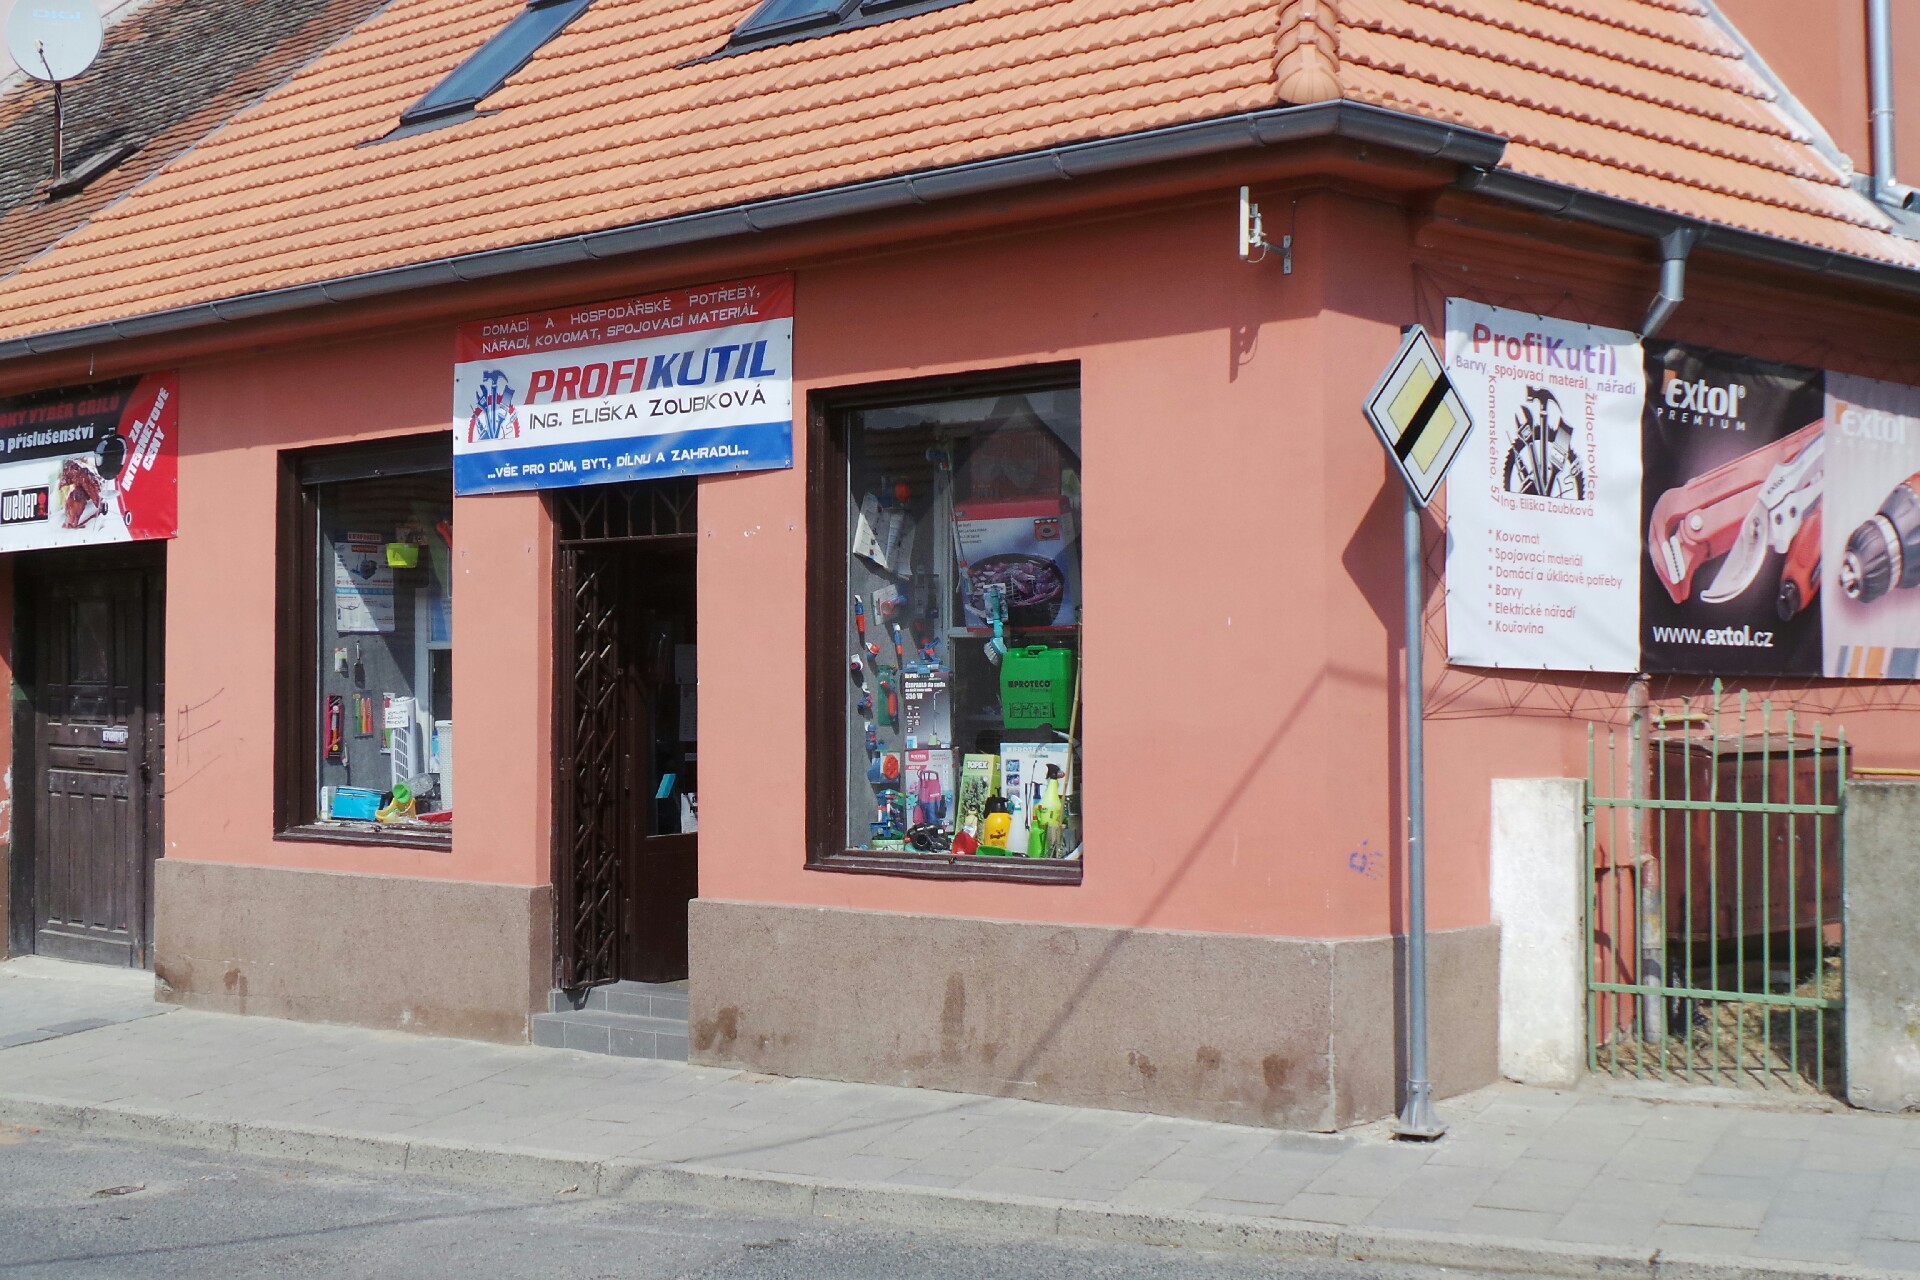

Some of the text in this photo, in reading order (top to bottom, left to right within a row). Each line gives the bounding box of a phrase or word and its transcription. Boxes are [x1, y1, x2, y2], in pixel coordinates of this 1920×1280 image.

[482, 285, 760, 336] DOMÁCÍ A HOSPODÁŘSKÉ POTŘEBY,
[482, 303, 759, 354] NÁŘADÍ, KOVOMAT, SPOJOVACÍ MATERIÁL
[1472, 322, 1616, 376] ProfiKutil
[1494, 363, 1544, 382] spojovací
[1597, 380, 1636, 395] nářadí
[529, 384, 766, 430] ING. ELIŠKA ZOUBKOVÁ
[1657, 407, 1746, 431] PREMIUM
[7, 422, 94, 454] příslušenství
[128, 420, 144, 443] ZA
[142, 425, 165, 471] CENY
[522, 464, 545, 476] PRO
[549, 458, 577, 474] DŮM,
[581, 457, 611, 471] BYT,
[616, 452, 651, 468] DÍLNU
[655, 452, 666, 463] A
[3, 490, 37, 521] weber
[1490, 485, 1500, 503] 57
[1501, 495, 1594, 517] Ing. Eliška Zoubková
[1495, 529, 1540, 545] Kovomat
[1495, 547, 1583, 567] Spojovací materiál
[1496, 566, 1623, 589] Domácí a úklidové potřeby
[1495, 584, 1523, 599] Barvy
[1495, 602, 1576, 619] Elektrické nářadí
[1653, 625, 1773, 647] www.extol.cz
[967, 761, 988, 769] TOPEX
